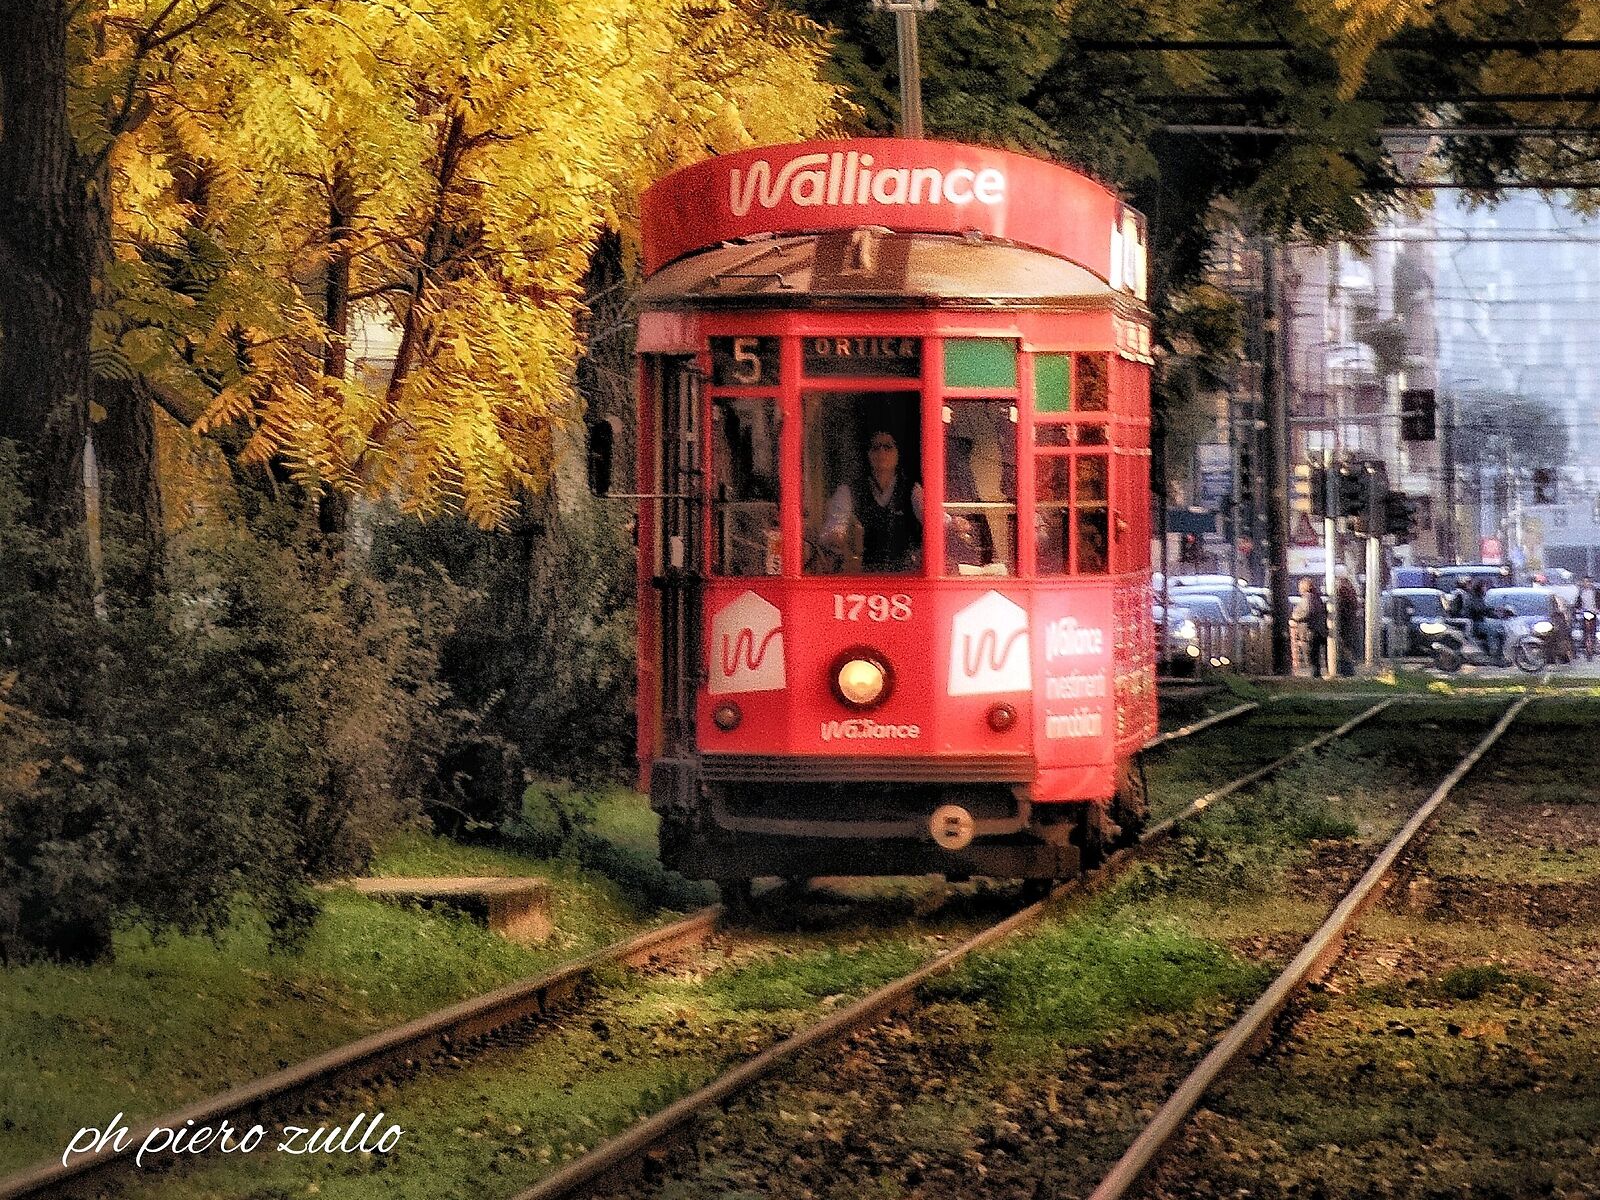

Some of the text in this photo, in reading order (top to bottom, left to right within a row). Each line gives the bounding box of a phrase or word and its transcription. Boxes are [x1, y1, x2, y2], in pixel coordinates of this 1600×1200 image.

[729, 150, 1005, 217] Walliance
[733, 336, 762, 384] 5
[833, 593, 912, 622] 1798
